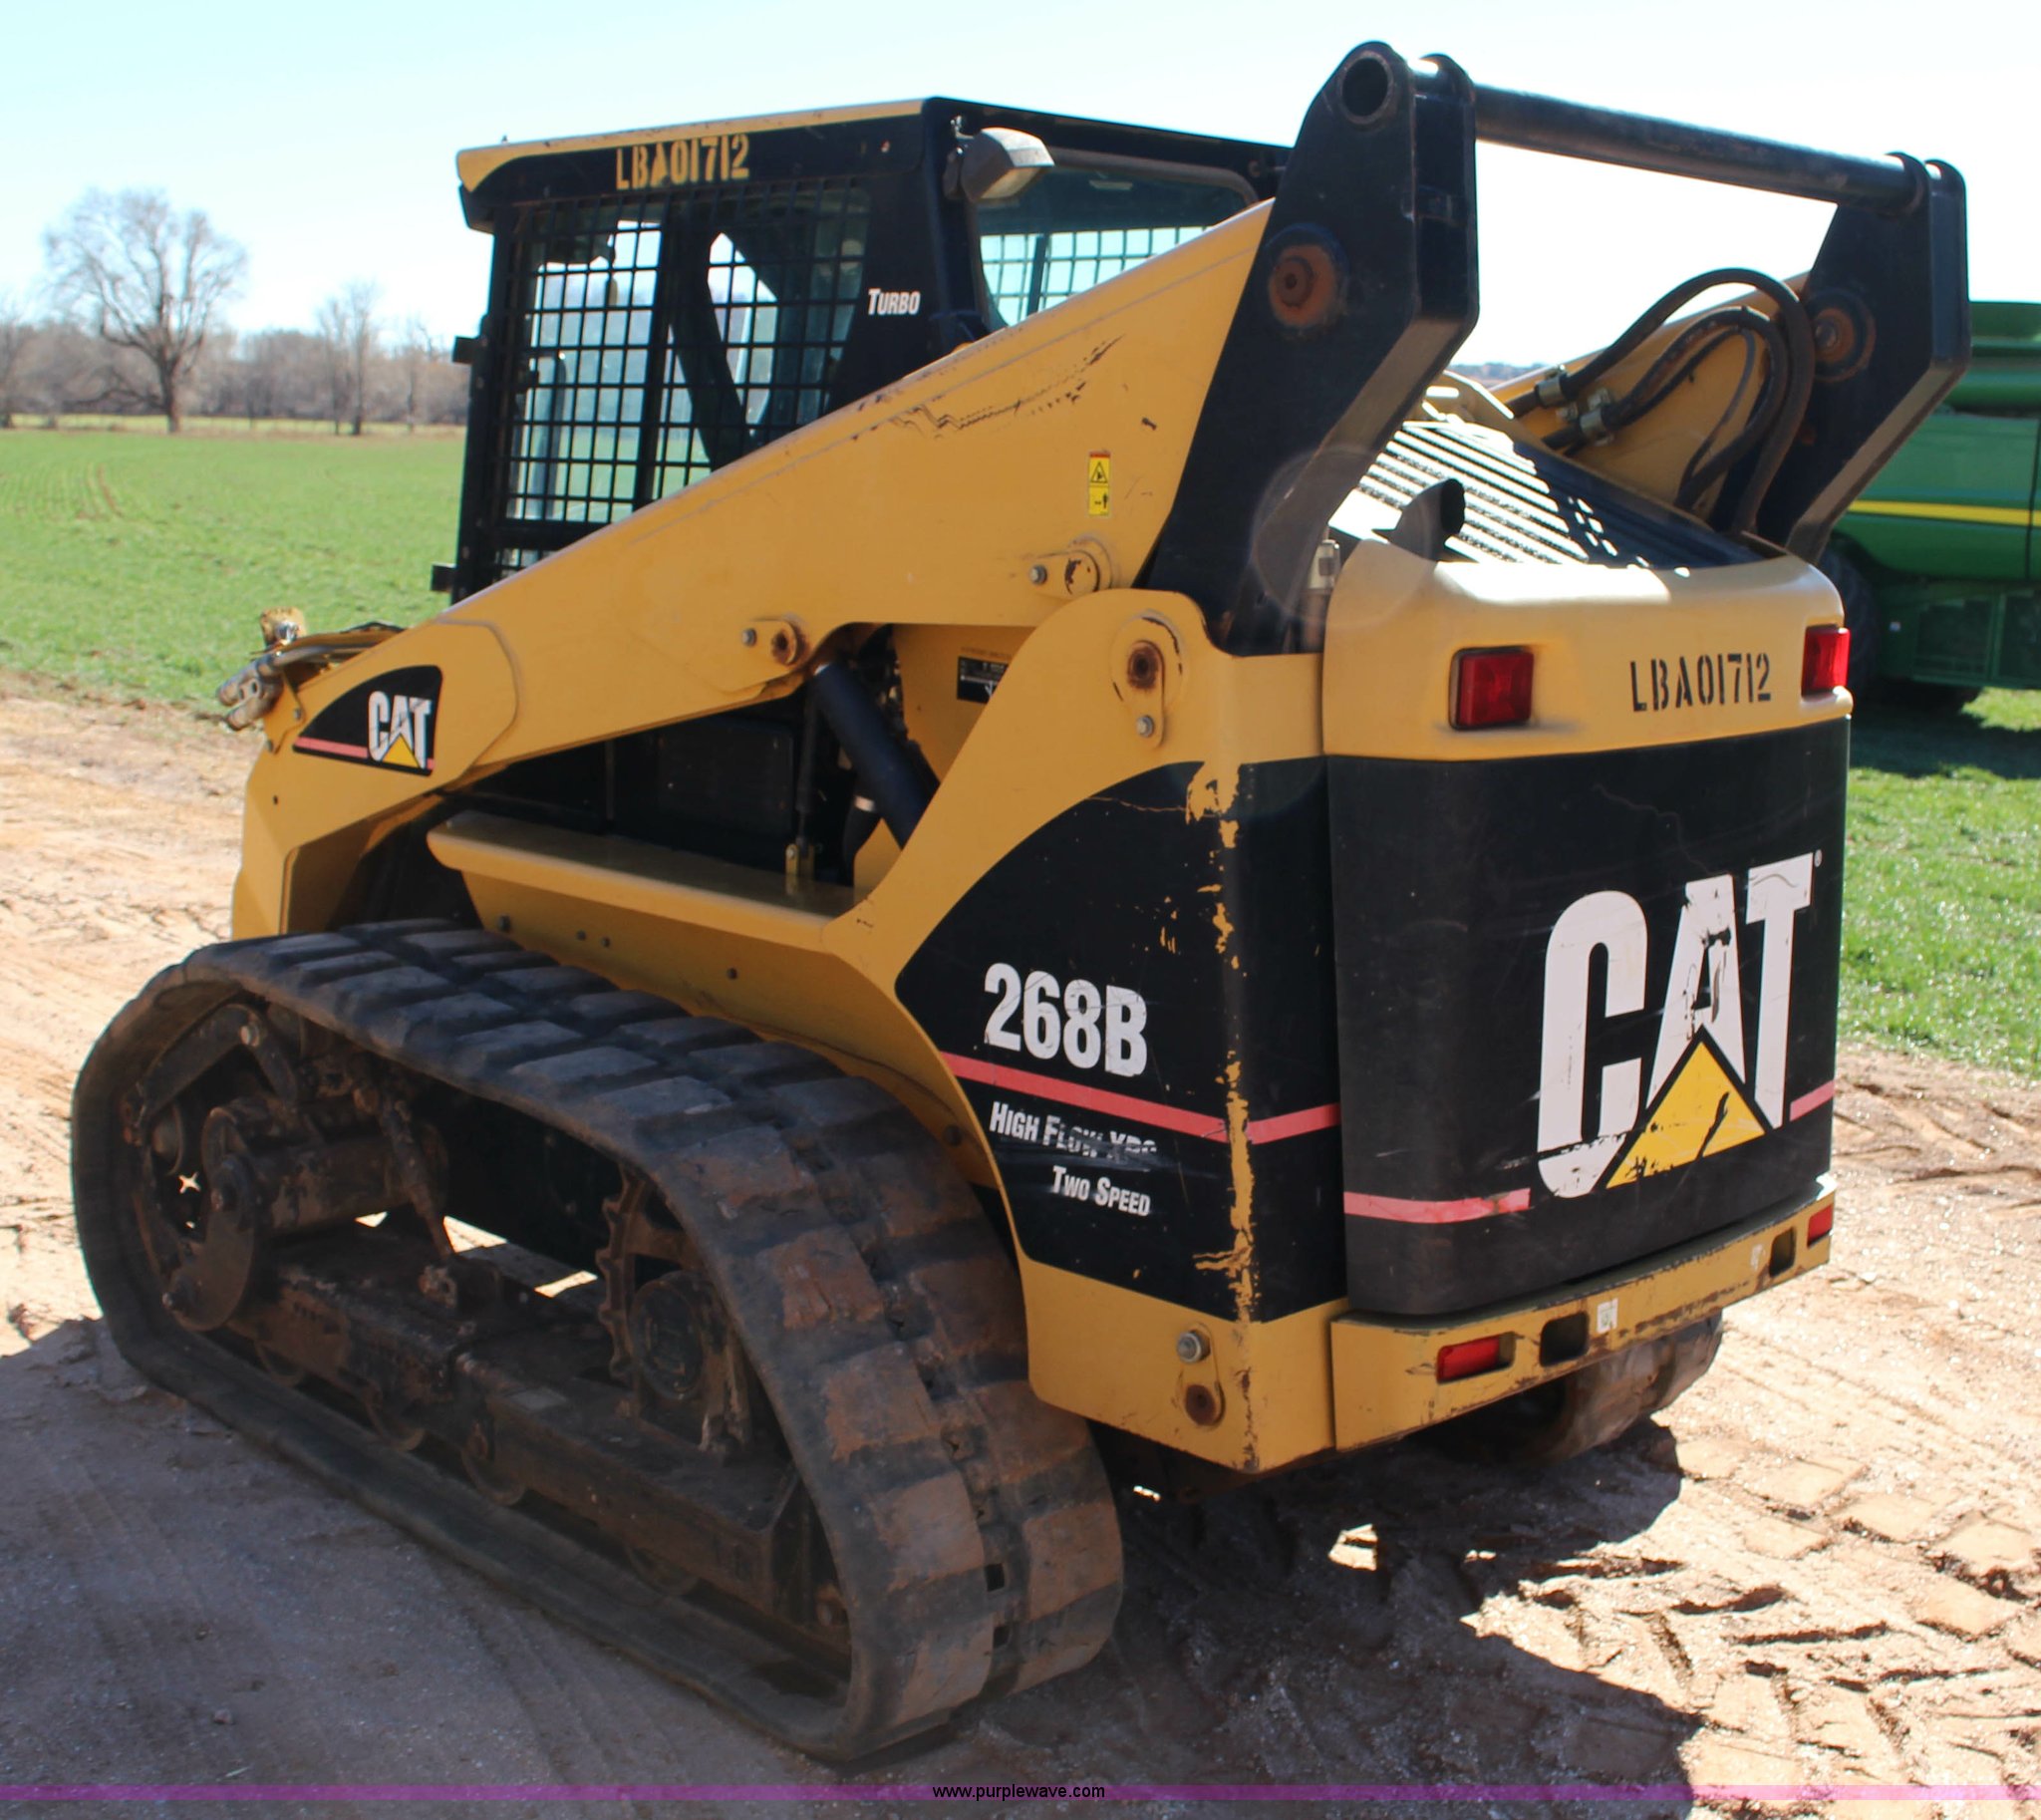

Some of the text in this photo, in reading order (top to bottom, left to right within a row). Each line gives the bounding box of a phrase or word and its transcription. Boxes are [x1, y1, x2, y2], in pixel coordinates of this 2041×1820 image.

[616, 134, 749, 189] LBA01712
[1630, 653, 1771, 712] LBA01712
[368, 690, 432, 769] CAT
[984, 962, 1147, 1077] 268B
[1537, 852, 1814, 1199] CAT
